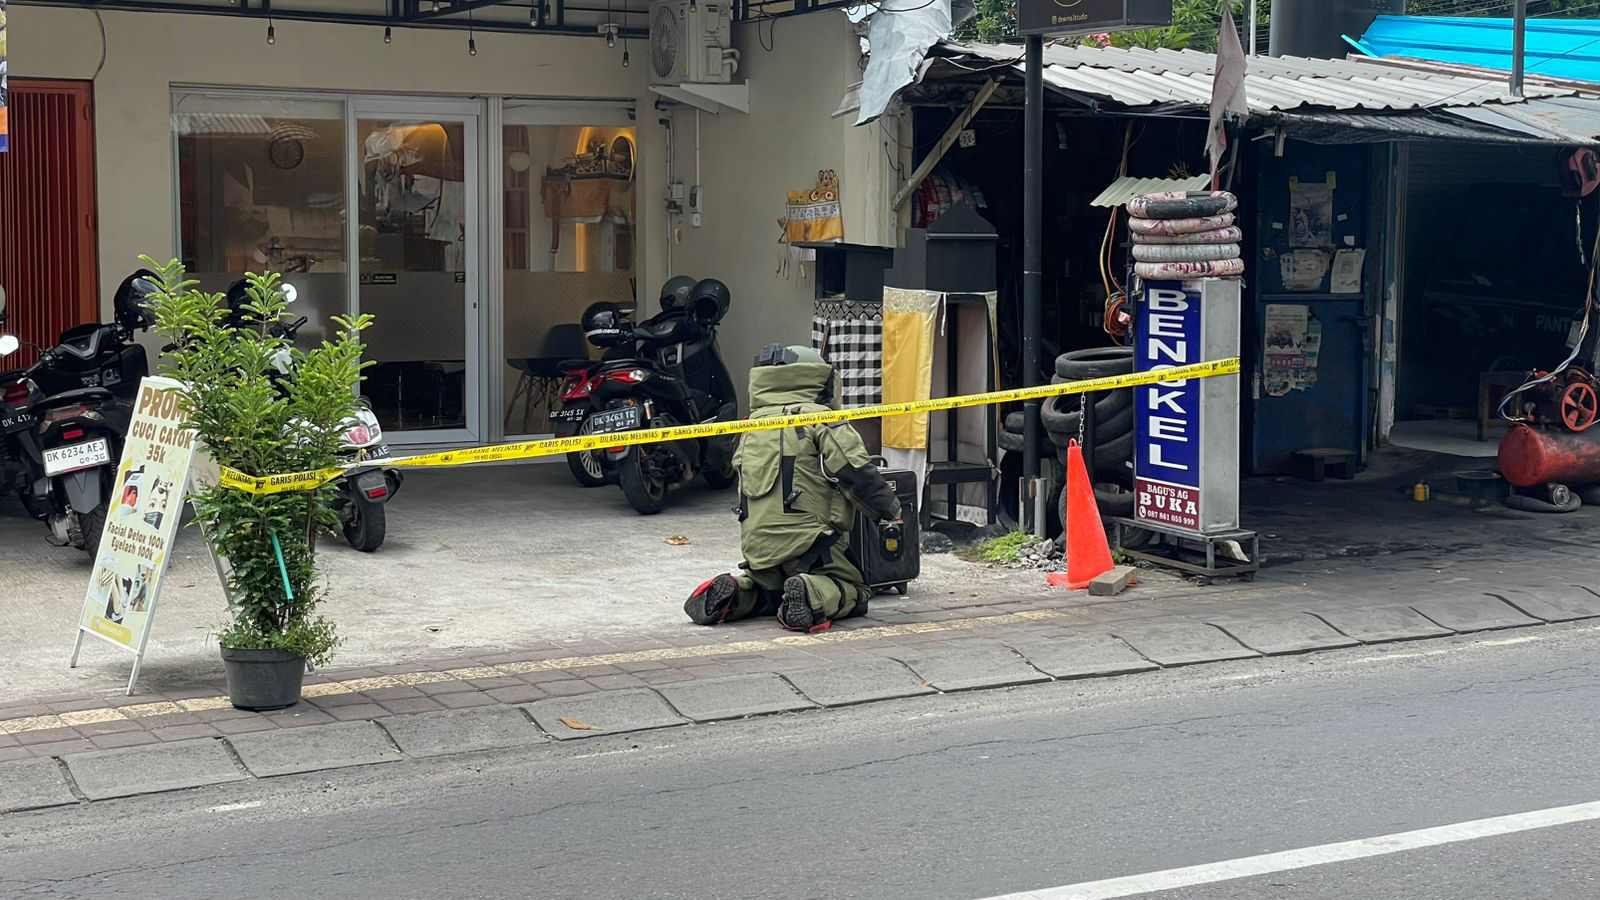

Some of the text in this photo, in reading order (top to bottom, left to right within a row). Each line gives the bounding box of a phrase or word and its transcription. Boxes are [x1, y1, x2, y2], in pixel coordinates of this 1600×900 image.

[138, 386, 193, 421] PROM
[132, 420, 157, 441] CUCI
[46, 451, 60, 463] DK
[61, 447, 84, 460] 6234
[270, 475, 292, 486] GARIS
[293, 472, 316, 483] POLISI
[539, 440, 559, 449] GARIS
[560, 438, 582, 447] POLISI
[600, 433, 629, 444] DILARANG
[630, 431, 659, 441] MELINTAS
[693, 426, 714, 435] POLISI
[1140, 491, 1198, 515] BUKA
[1147, 484, 1189, 500] BAGU'S AG
[107, 520, 128, 537] Facial
[127, 527, 146, 545] Detox
[112, 536, 136, 555] Eyelash
